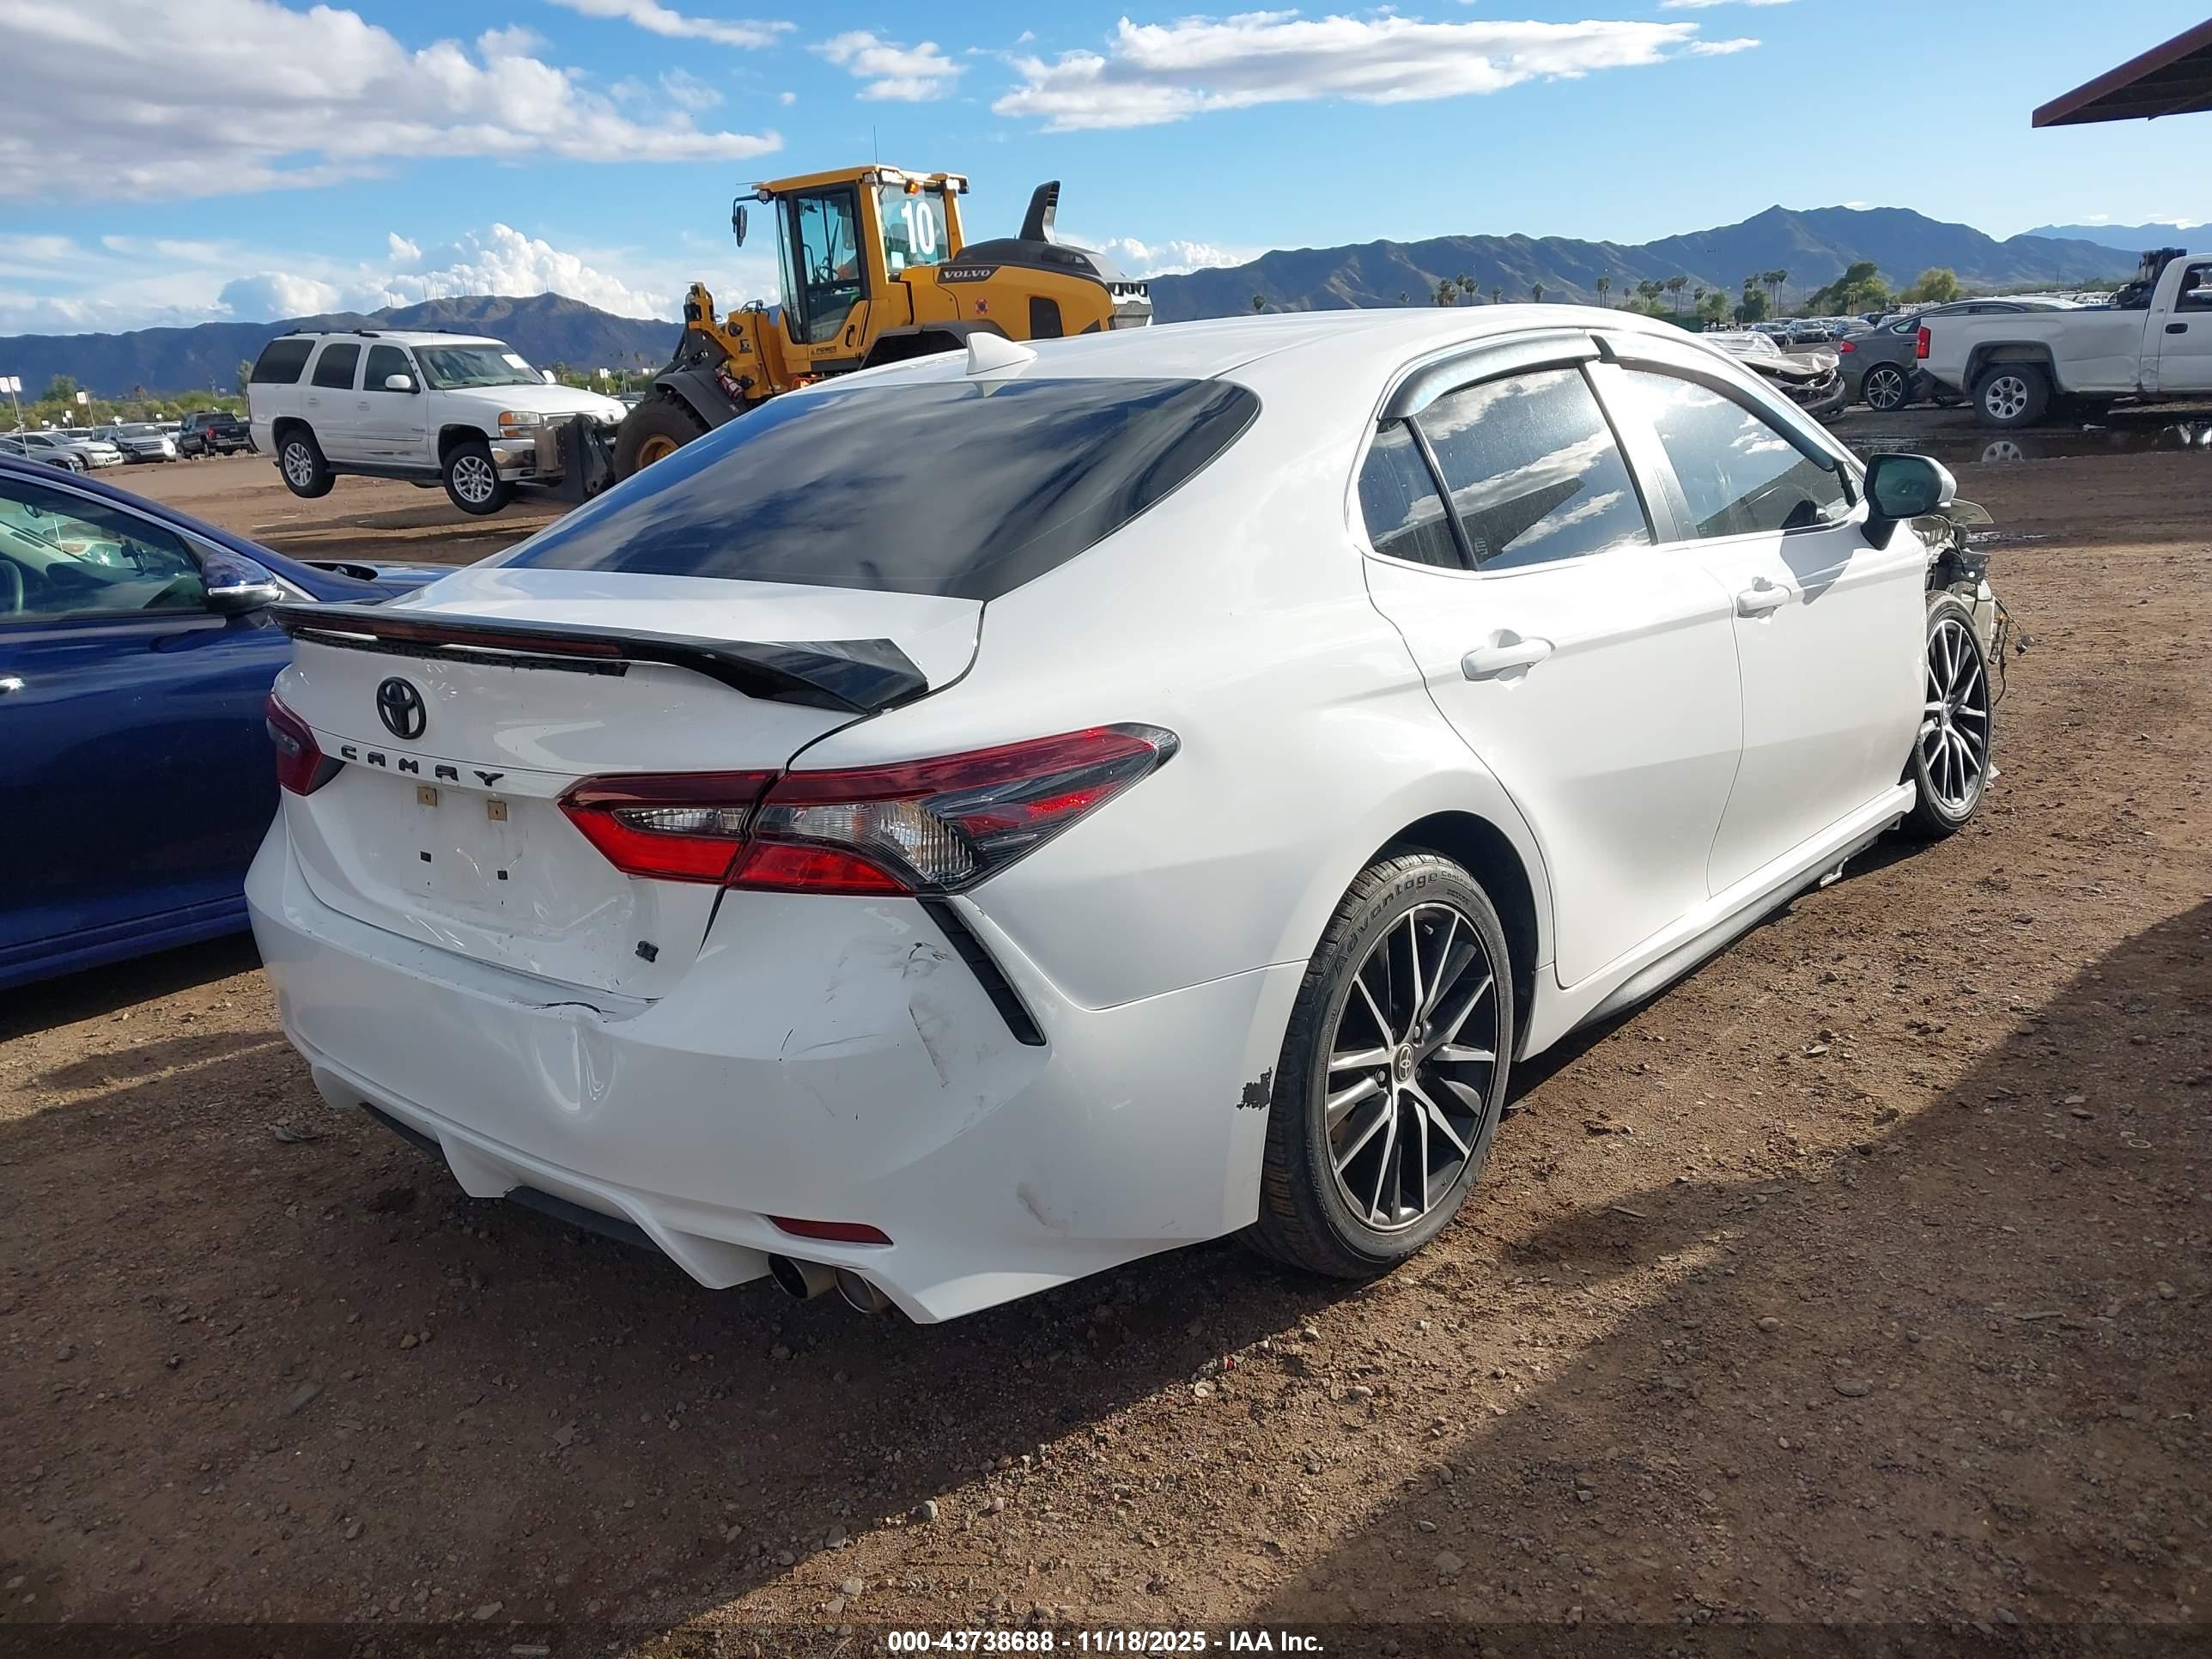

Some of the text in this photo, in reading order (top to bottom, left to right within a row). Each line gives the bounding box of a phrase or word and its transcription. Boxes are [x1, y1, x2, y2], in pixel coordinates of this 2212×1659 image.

[901, 200, 935, 255] 10
[944, 269, 991, 279] VOLVO
[341, 744, 504, 787] CAMRY
